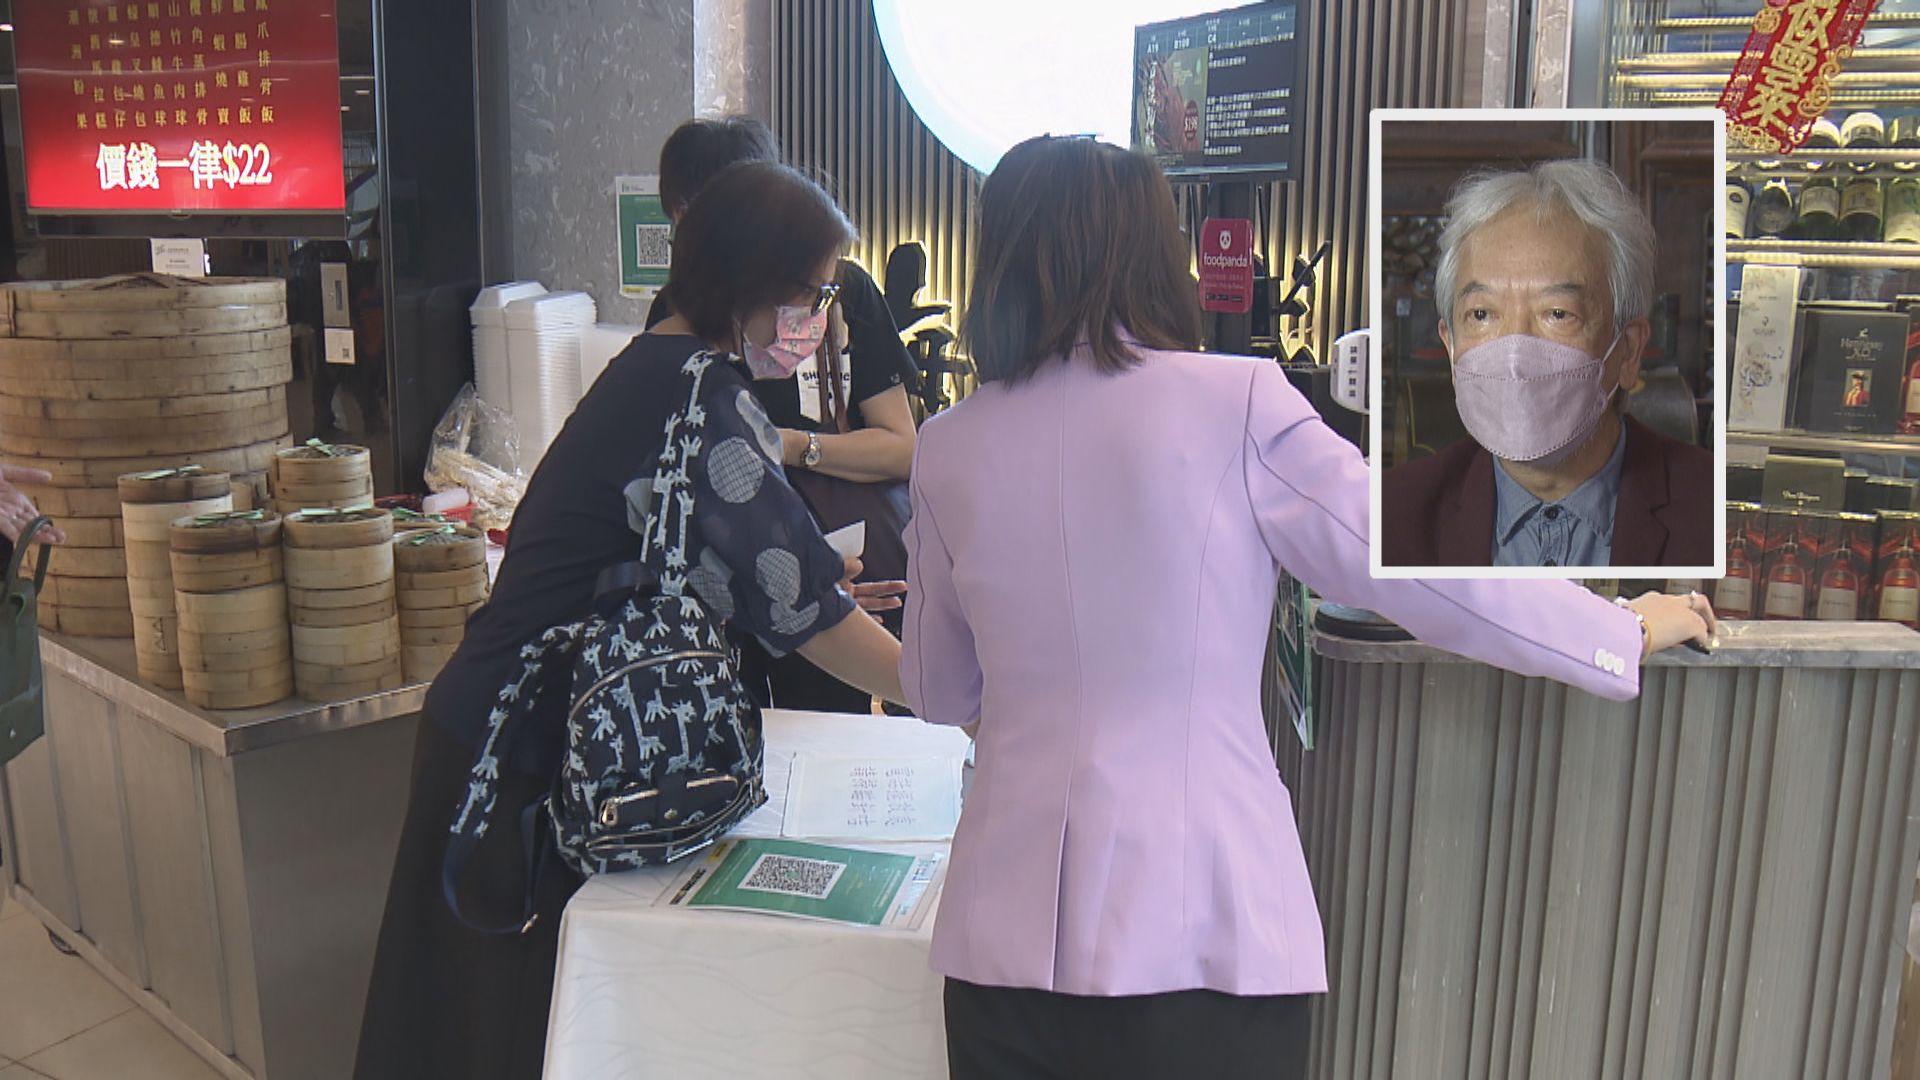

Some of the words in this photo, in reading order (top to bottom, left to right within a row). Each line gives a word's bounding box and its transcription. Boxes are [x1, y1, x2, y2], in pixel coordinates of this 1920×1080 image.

[168, 1, 189, 126] 山竹牛肉球
[1741, 0, 1838, 131] 似雲來
[96, 140, 273, 190] 價錢一律$22
[1203, 252, 1248, 270] foodpanda
